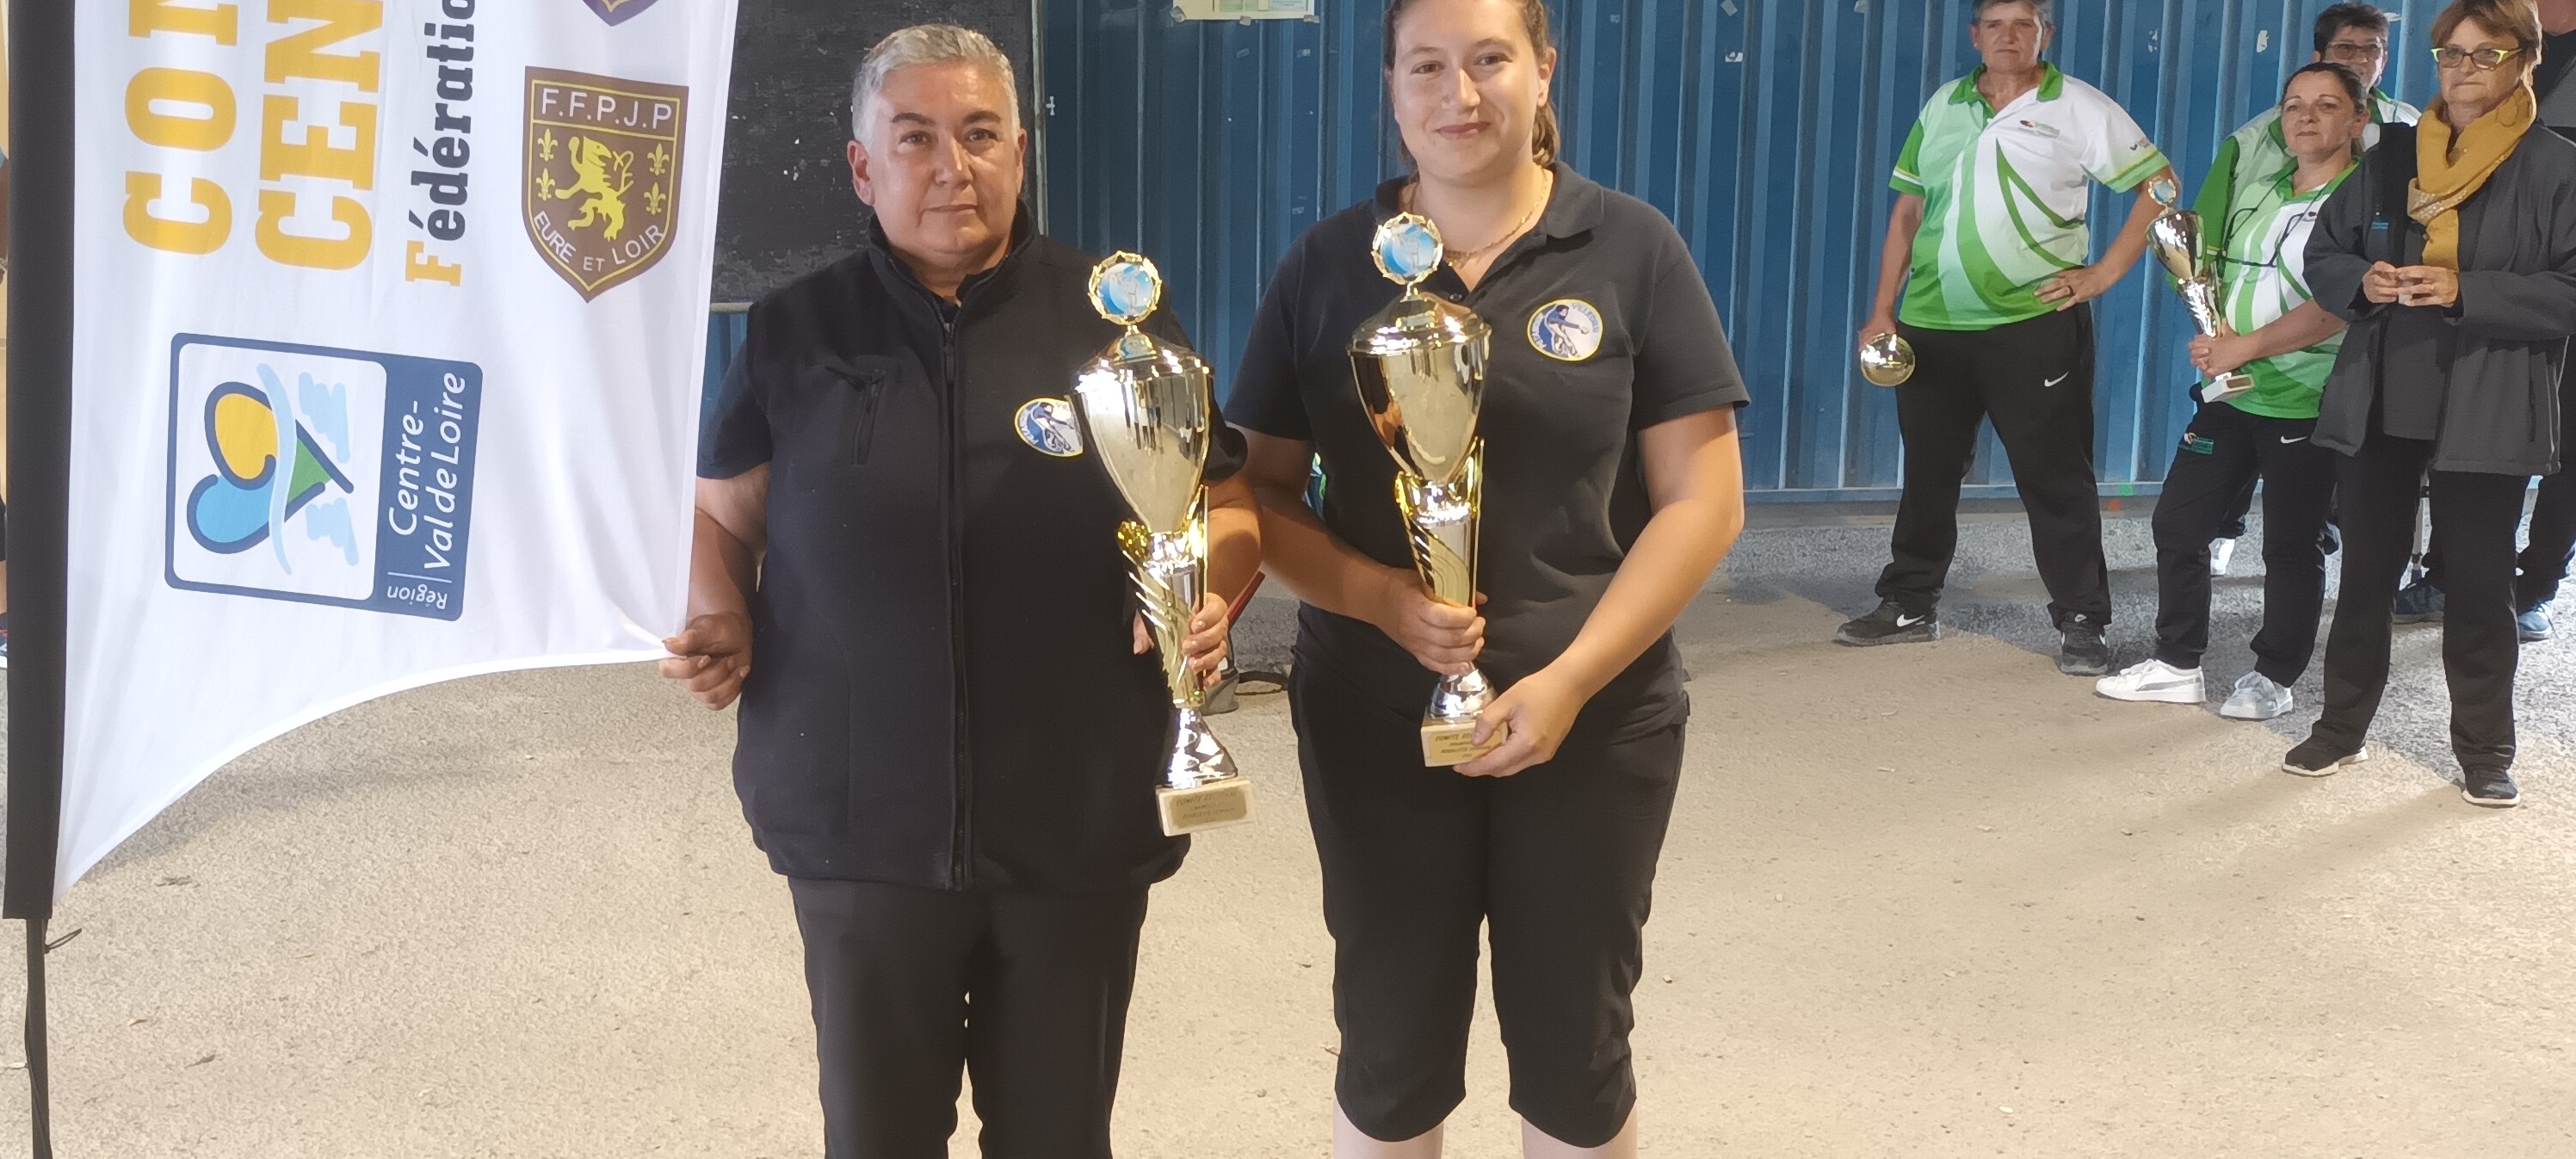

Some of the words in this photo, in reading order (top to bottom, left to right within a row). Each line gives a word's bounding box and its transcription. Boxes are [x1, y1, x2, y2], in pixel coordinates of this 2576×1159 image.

[534, 211, 576, 263] EURE
[583, 256, 605, 272] ET
[611, 225, 664, 266] LOIR
[389, 400, 423, 535] Centre-
[386, 583, 448, 610] Région
